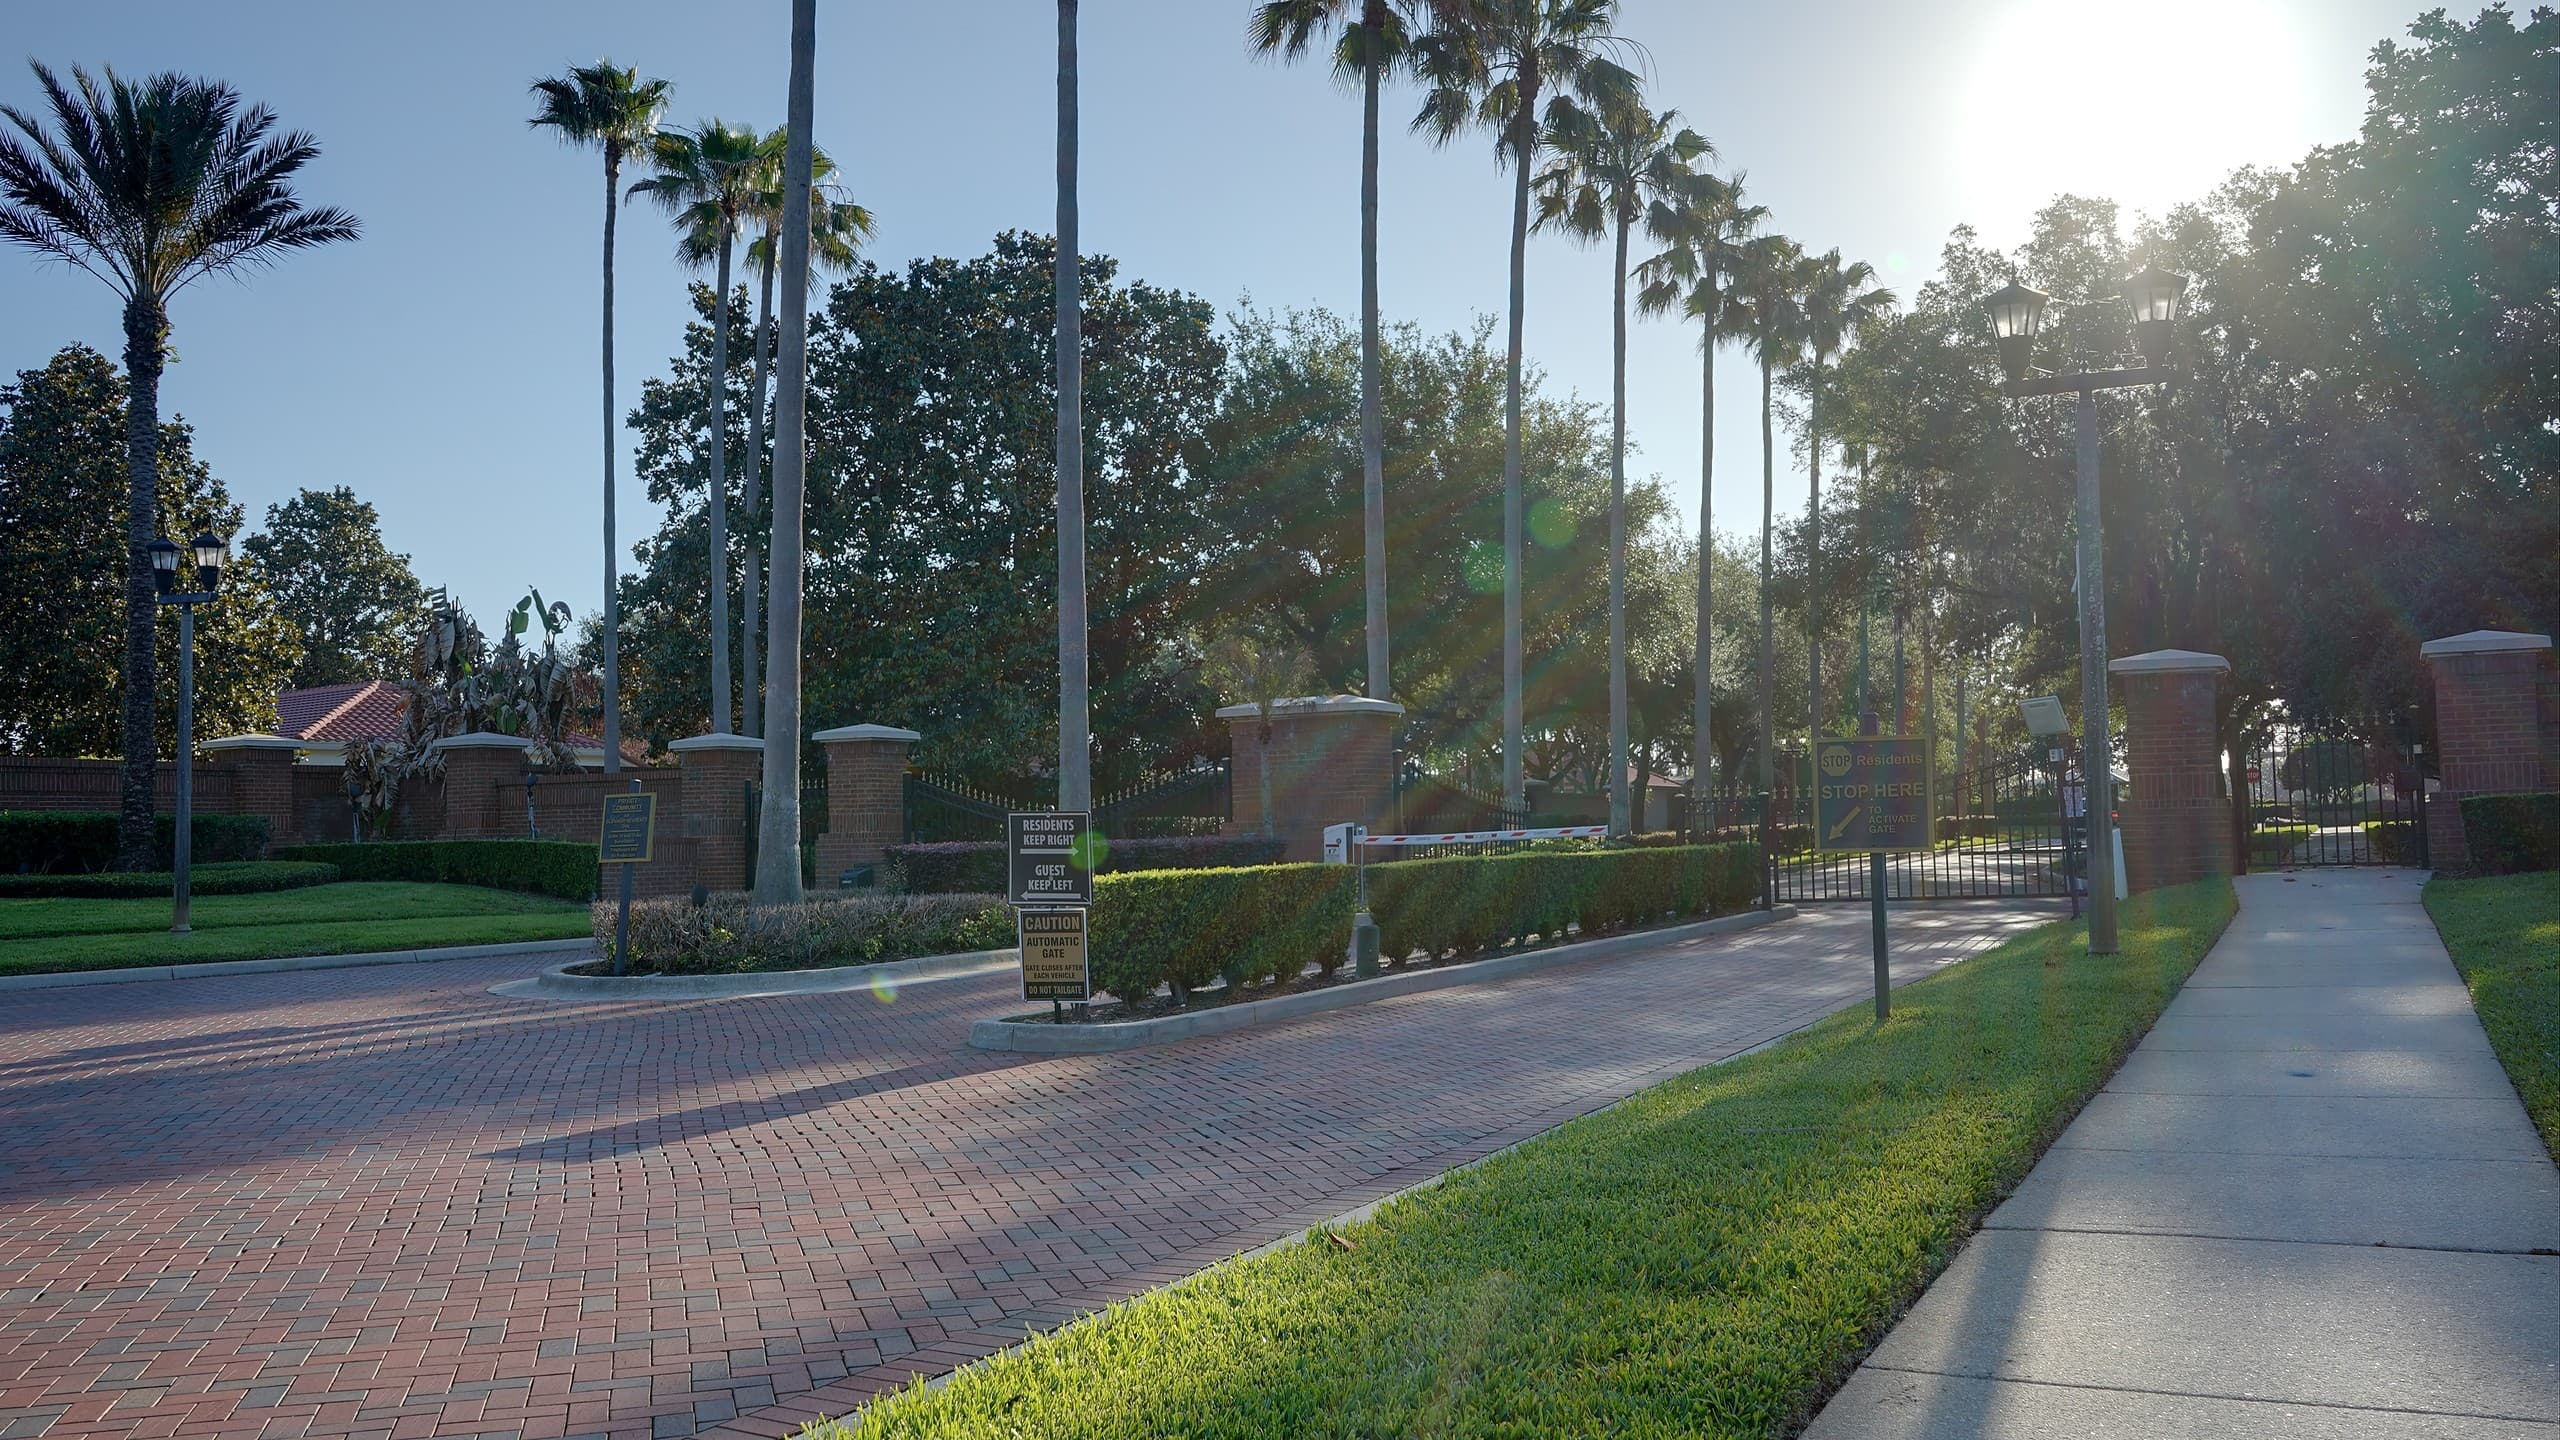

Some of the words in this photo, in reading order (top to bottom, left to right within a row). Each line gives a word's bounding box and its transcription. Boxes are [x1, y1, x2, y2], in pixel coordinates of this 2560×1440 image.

[1823, 755, 1850, 768] STOP
[1857, 754, 1922, 766] Residents
[1822, 785, 1868, 799] STOP
[1875, 783, 1924, 797] HERE
[1868, 806, 1881, 814] TO
[1869, 815, 1917, 823] ACTIVATE
[1023, 819, 1074, 831] RESIDENTS
[1869, 825, 1897, 833] GATE
[1023, 835, 1045, 845] KEEP
[1048, 835, 1075, 845] RIGHT
[1035, 865, 1065, 876] GUEST
[1028, 880, 1050, 890] KEEP
[1053, 880, 1073, 890] LEFT
[1025, 916, 1080, 930] CAUTION
[1027, 937, 1079, 946] AUTOMATIC
[1042, 949, 1064, 958] GATE
[1029, 986, 1037, 994] DO
[1040, 986, 1051, 994] NOT
[1054, 986, 1082, 994] TAILGATE
